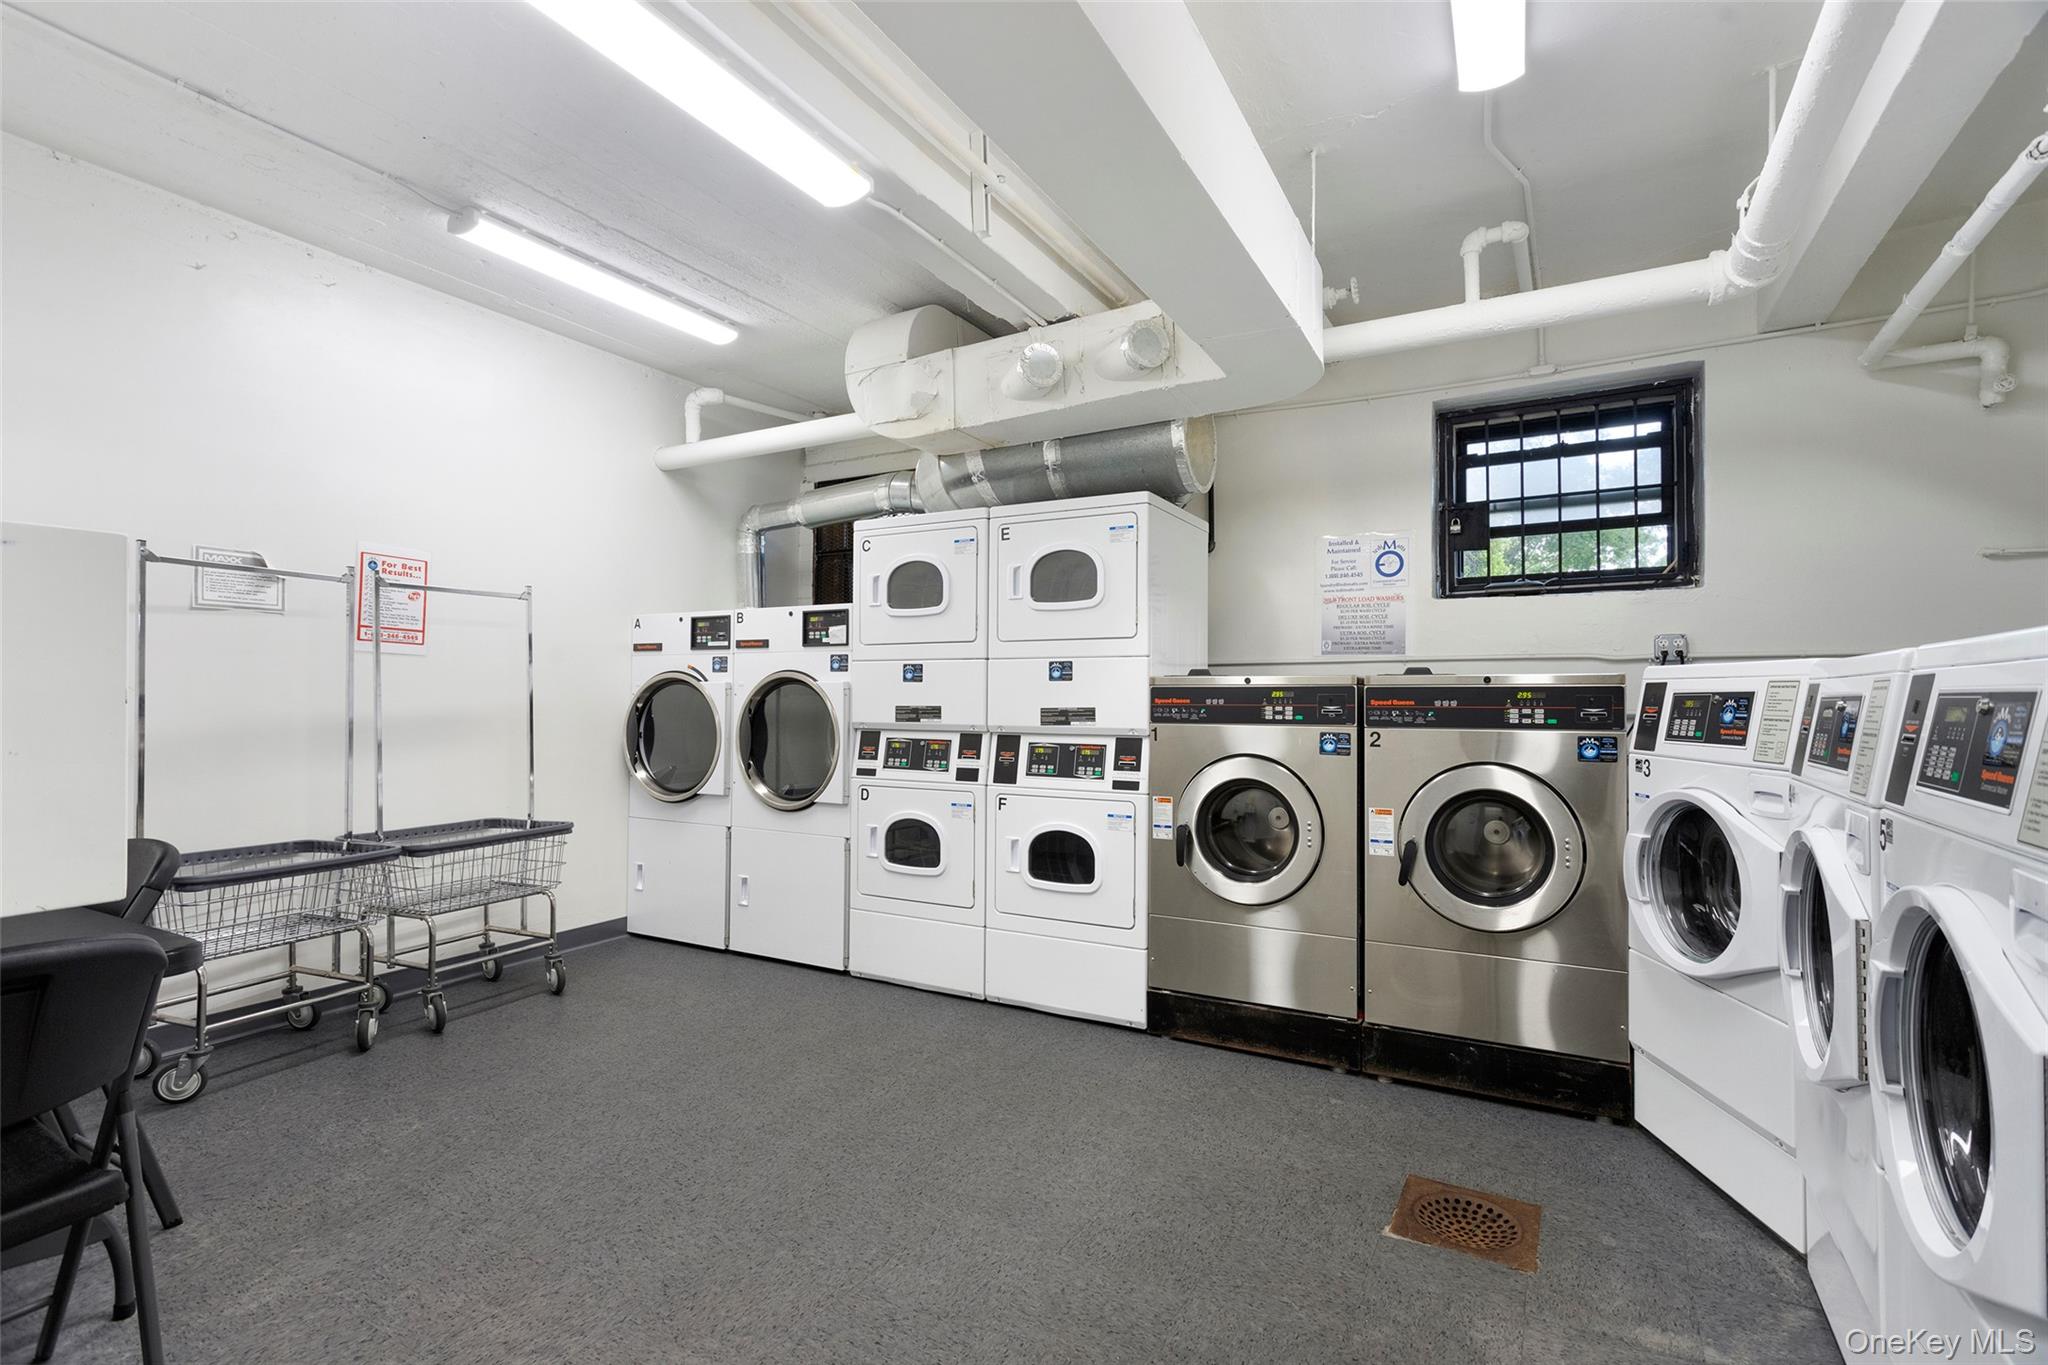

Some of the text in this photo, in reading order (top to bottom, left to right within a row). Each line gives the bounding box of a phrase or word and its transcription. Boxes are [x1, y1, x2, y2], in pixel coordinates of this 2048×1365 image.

[1001, 528, 1010, 541] E
[861, 540, 871, 552] C
[204, 554, 242, 564] MAXX
[382, 560, 422, 572] For Best
[634, 618, 641, 629] A
[736, 612, 744, 624] B
[364, 632, 418, 641] 1--246-4545
[1151, 728, 1158, 741] 1
[1370, 731, 1381, 747] 2
[1643, 759, 1650, 777] 3
[861, 788, 869, 801] D
[998, 798, 1007, 810] F
[1880, 818, 1887, 851] 5
